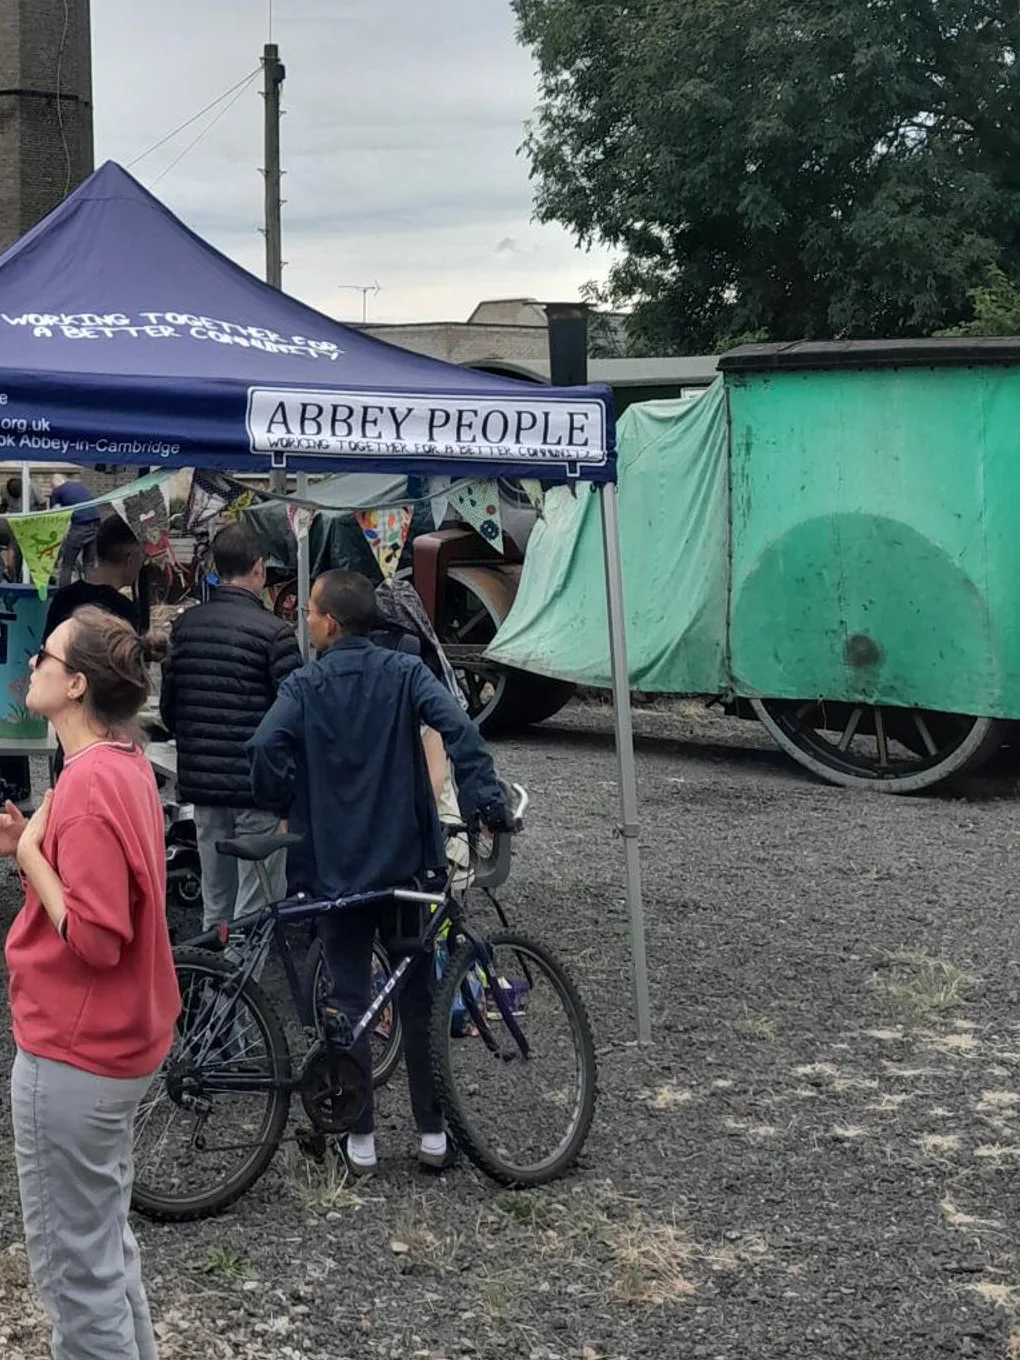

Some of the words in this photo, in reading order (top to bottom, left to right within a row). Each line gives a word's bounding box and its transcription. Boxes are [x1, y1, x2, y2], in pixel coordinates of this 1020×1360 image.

[0, 313, 131, 326] WORKING
[139, 312, 288, 343] TOGETHER
[33, 326, 53, 338] A
[60, 325, 182, 338] BETTER
[265, 401, 415, 440] ABBEY
[427, 407, 590, 447] PEOPLE
[19, 434, 181, 457] Abbey-in-Cambridge
[267, 437, 330, 450] WORKING
[334, 440, 410, 453] TOGETHER
[414, 443, 440, 455] FOR
[445, 445, 454, 454] A
[460, 445, 514, 457] BETTER
